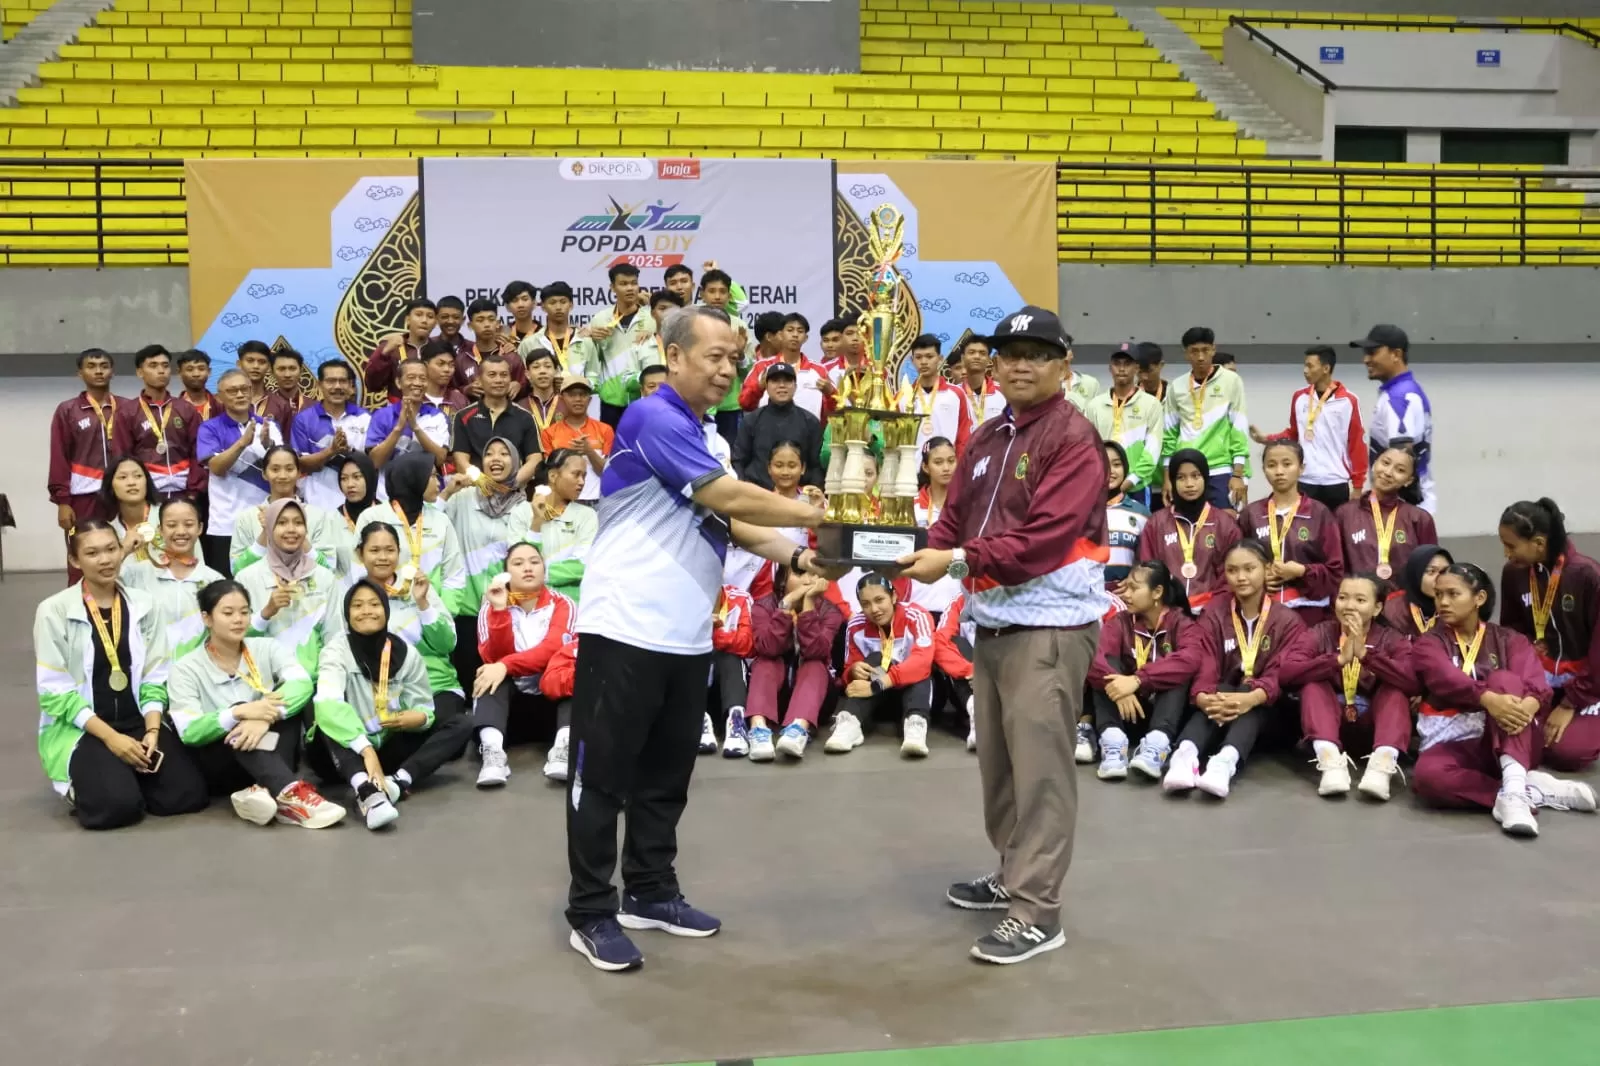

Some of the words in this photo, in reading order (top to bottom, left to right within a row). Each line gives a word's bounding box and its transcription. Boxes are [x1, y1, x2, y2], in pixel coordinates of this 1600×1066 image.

[588, 161, 642, 176] DIKPORA
[560, 235, 647, 253] POPDA
[653, 234, 696, 252] DIY
[627, 255, 663, 267] 2025
[741, 285, 797, 304] ERAH
[1010, 314, 1034, 333] YK
[1164, 531, 1178, 546] YK
[1352, 529, 1366, 544] YK
